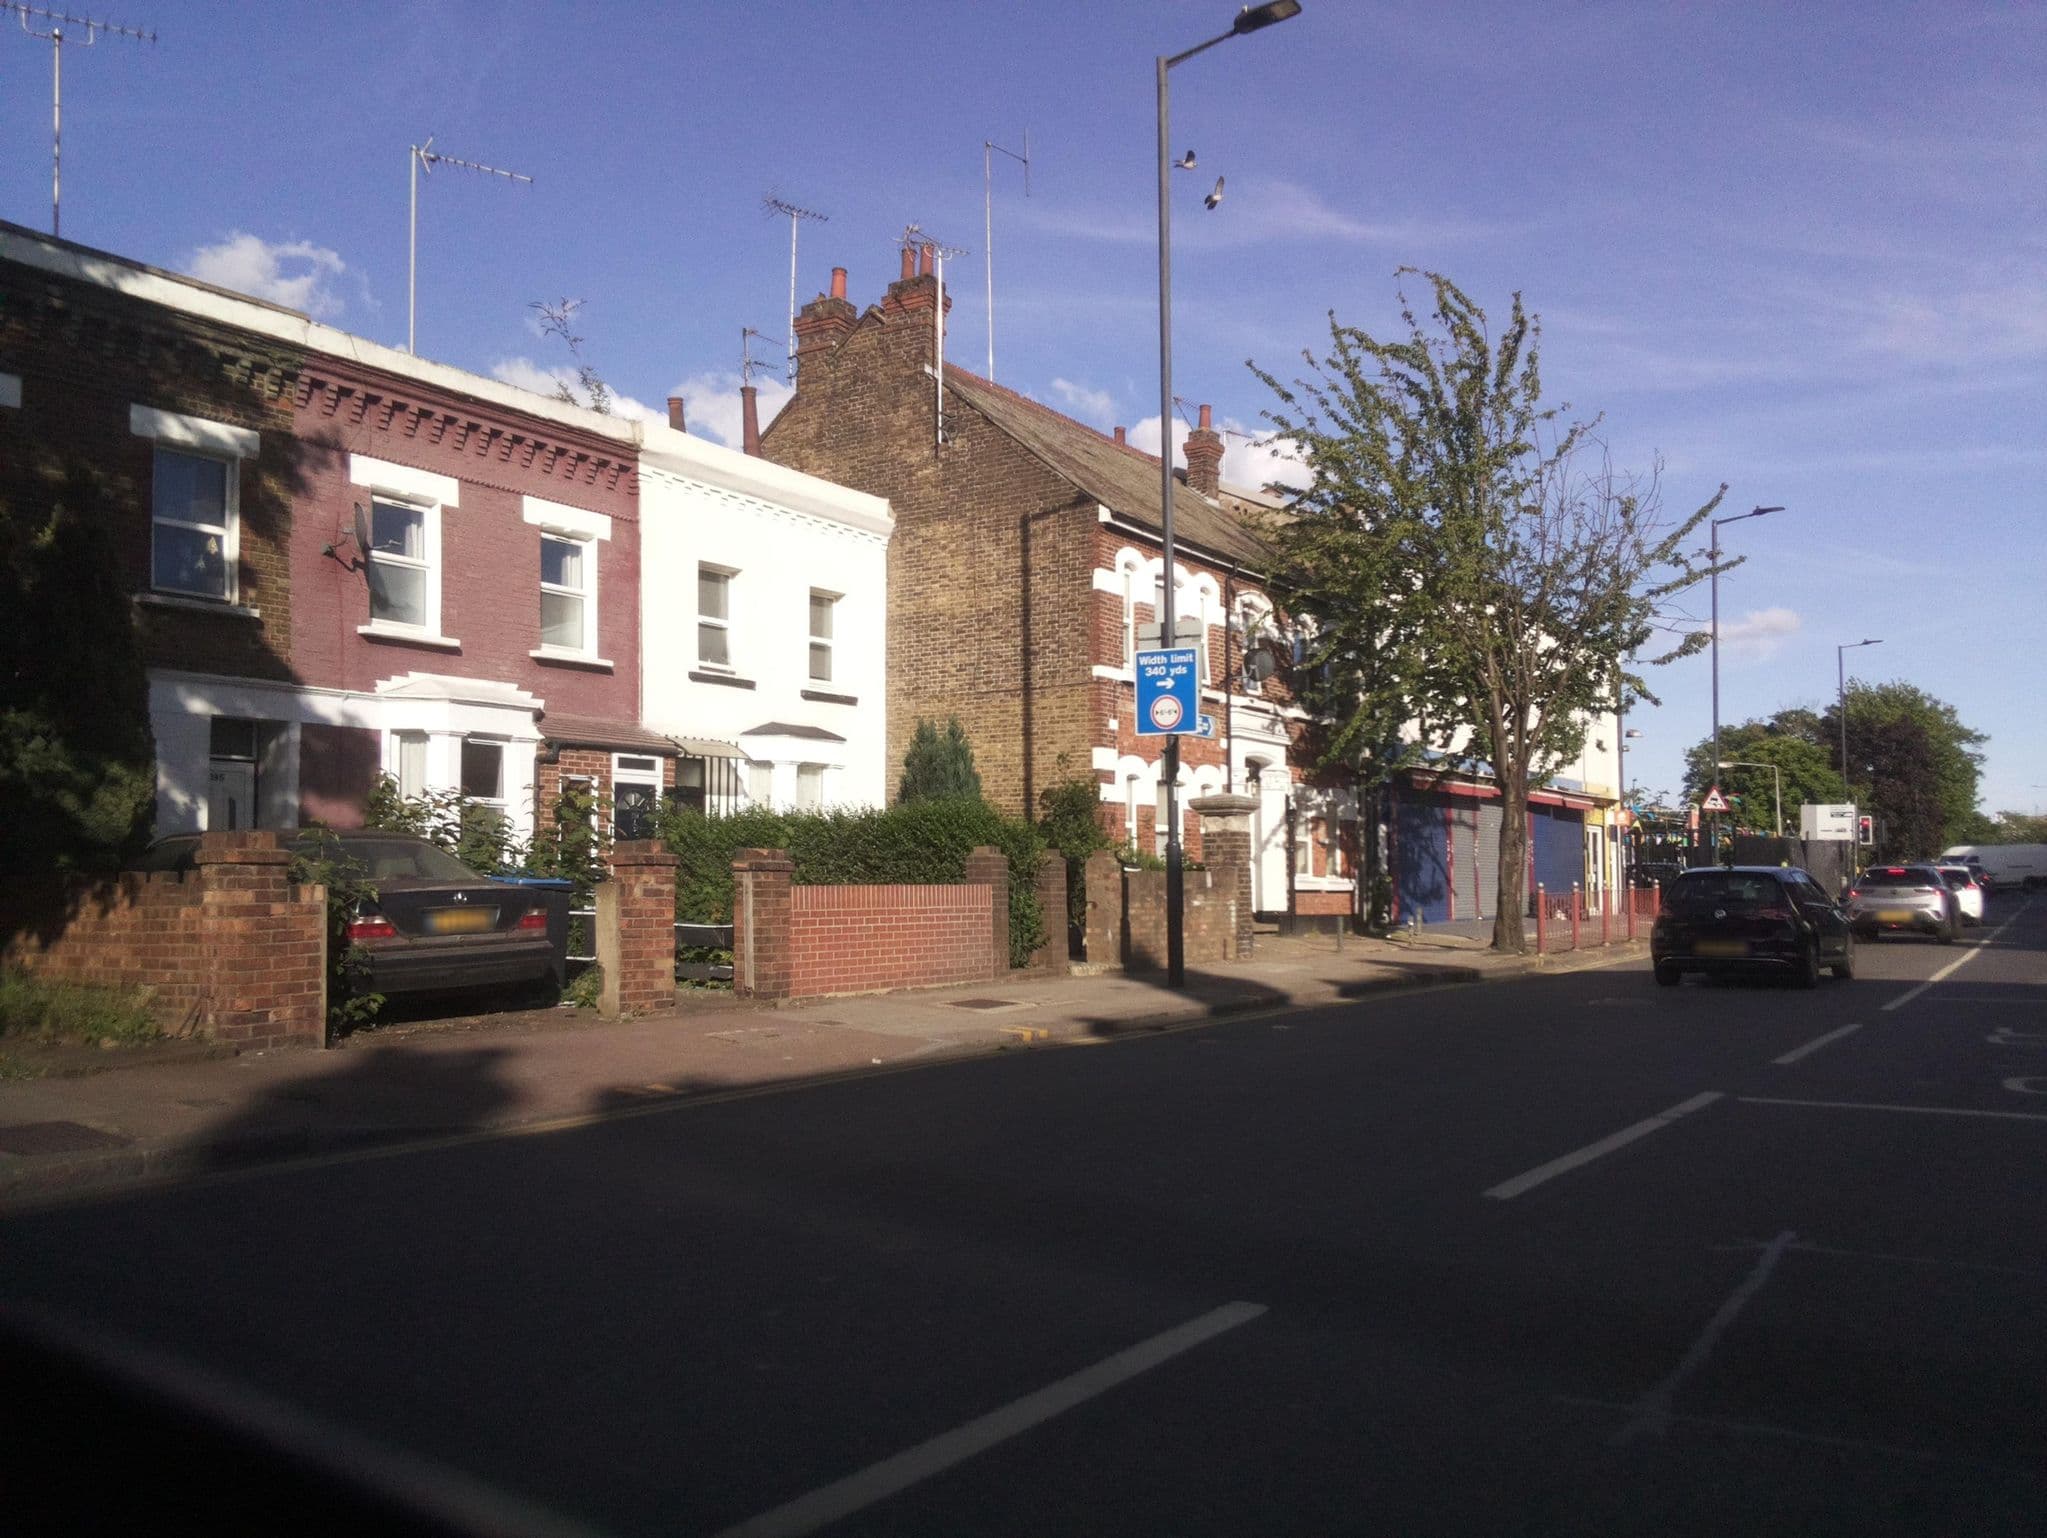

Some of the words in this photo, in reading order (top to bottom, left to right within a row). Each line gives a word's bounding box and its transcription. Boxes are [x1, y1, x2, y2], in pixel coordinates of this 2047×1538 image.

[1139, 655, 1167, 666] Width
[1145, 666, 1166, 676] 340
[1170, 665, 1187, 676] yds
